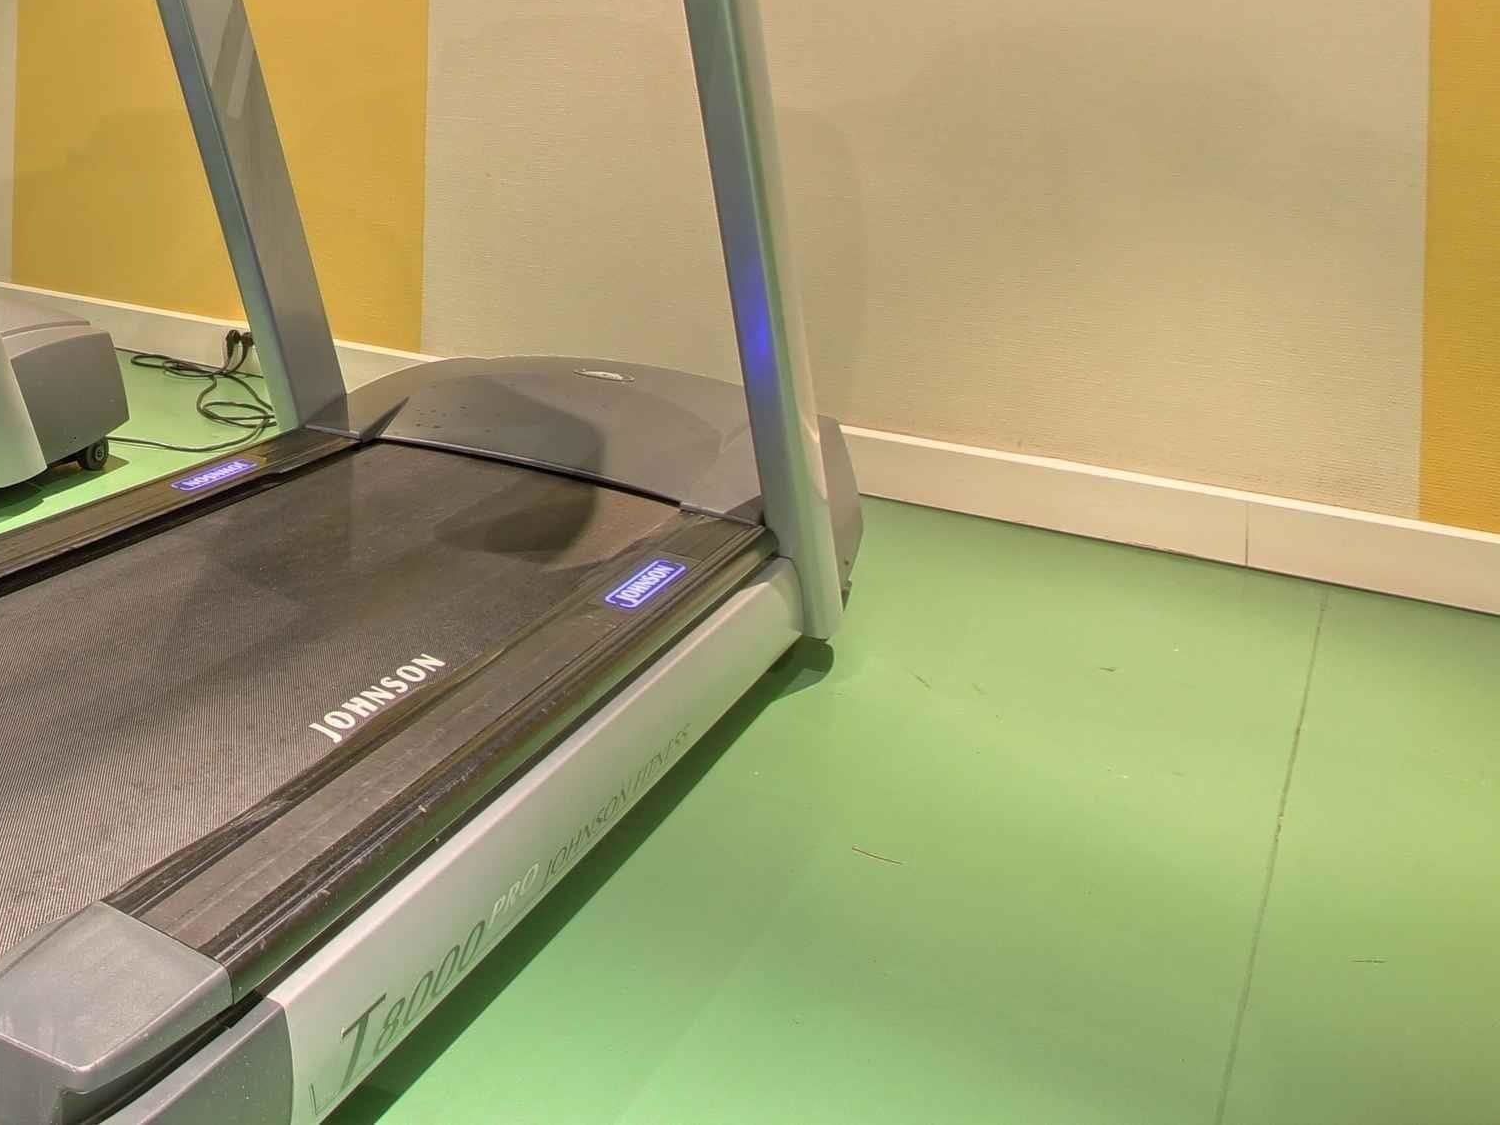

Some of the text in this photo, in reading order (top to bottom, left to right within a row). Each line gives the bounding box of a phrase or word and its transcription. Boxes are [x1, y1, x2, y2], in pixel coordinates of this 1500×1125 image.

[614, 564, 676, 604] JOHNSON
[307, 653, 447, 744] JOHNSON
[340, 920, 486, 1093] T8000
[488, 862, 540, 929] PRO
